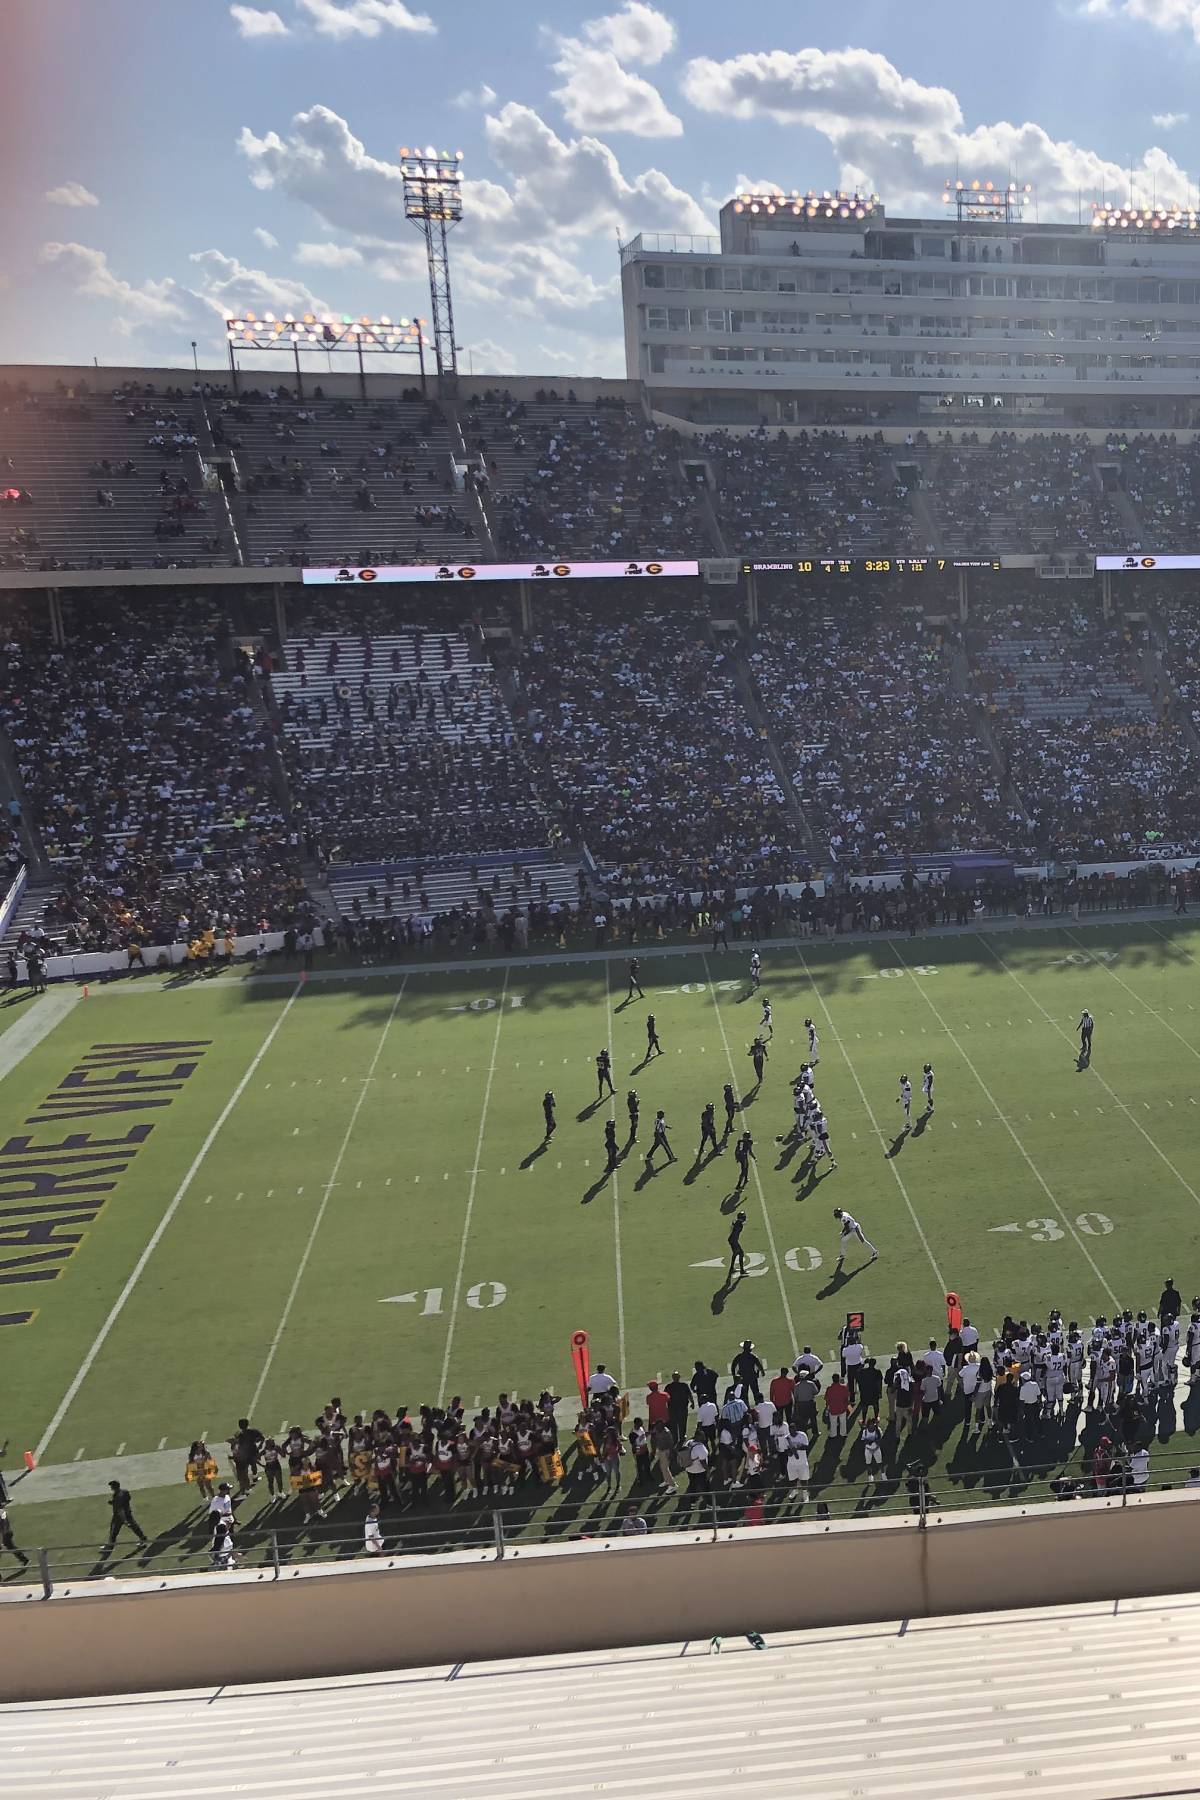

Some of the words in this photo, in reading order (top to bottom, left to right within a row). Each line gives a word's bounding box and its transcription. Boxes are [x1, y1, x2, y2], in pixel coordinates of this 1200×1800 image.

[798, 562, 812, 572] 10
[865, 561, 890, 571] 3:23
[937, 560, 945, 570] 7
[23, 1040, 213, 1124] VIEW
[1026, 1212, 1115, 1242] 30
[731, 1246, 823, 1278] 20
[418, 1281, 508, 1316] 10
[850, 1314, 859, 1327] 2
